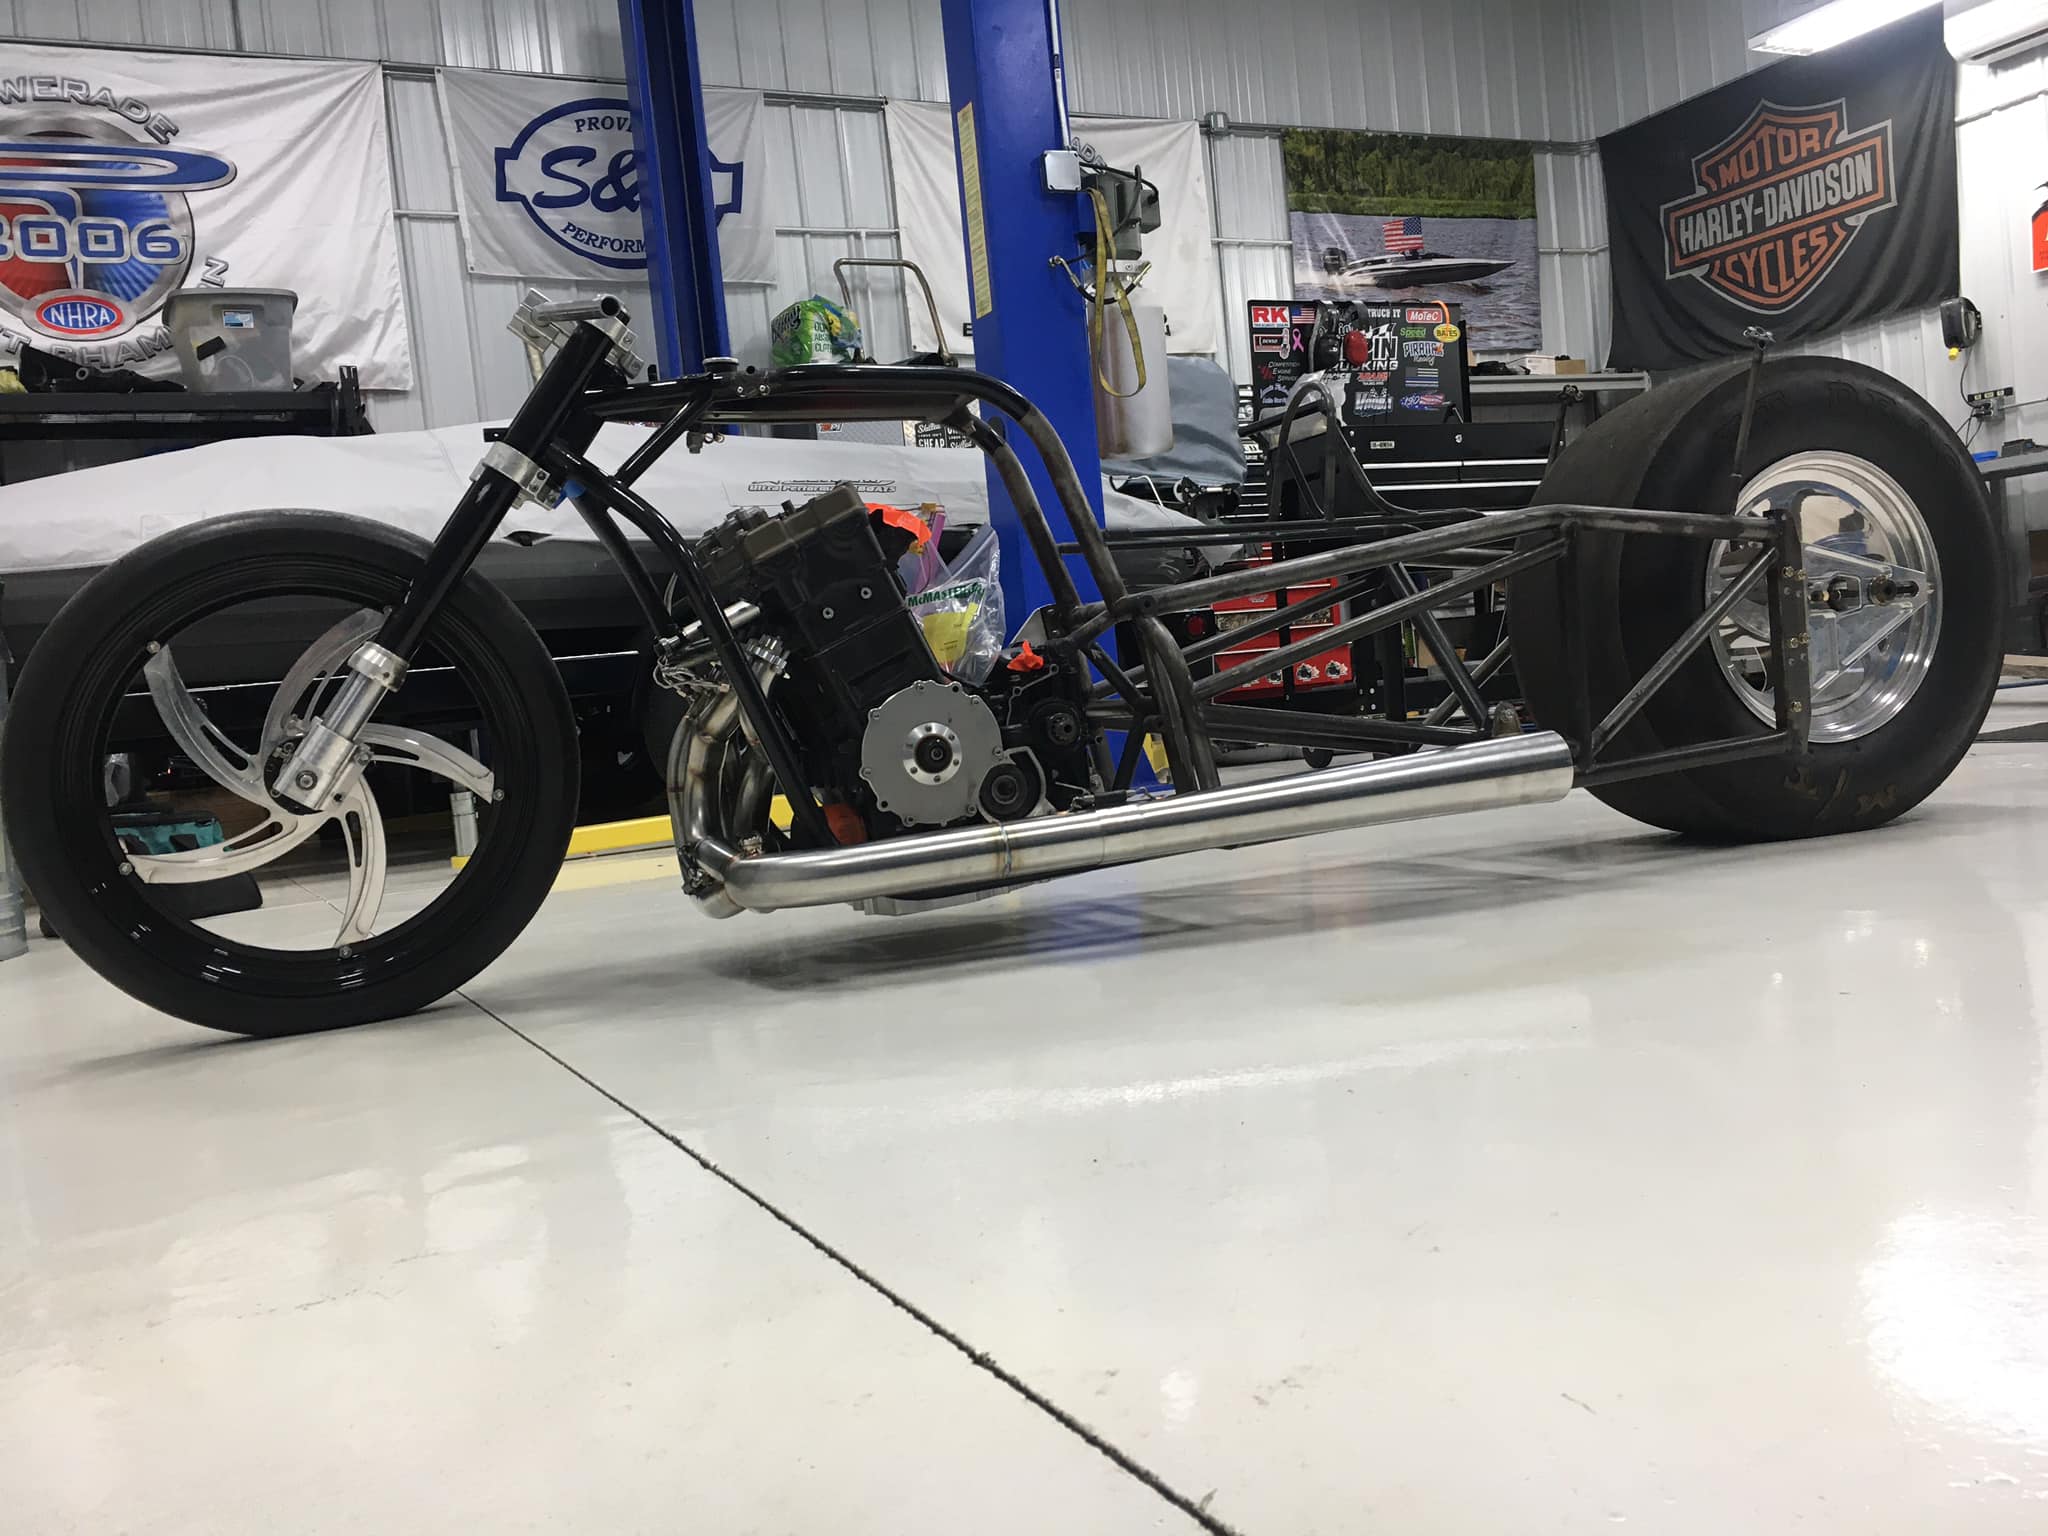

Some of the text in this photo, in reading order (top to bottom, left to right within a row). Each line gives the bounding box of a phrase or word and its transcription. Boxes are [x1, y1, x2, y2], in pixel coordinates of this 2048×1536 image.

[575, 115, 632, 133] PROV
[1718, 125, 1821, 189] MOTOR
[1679, 151, 1873, 255] HARLEY-DAVIDSON
[0, 214, 187, 264] 006
[1725, 225, 1828, 294] CYCLES
[51, 303, 111, 328] NHRA
[1252, 307, 1289, 323] RK
